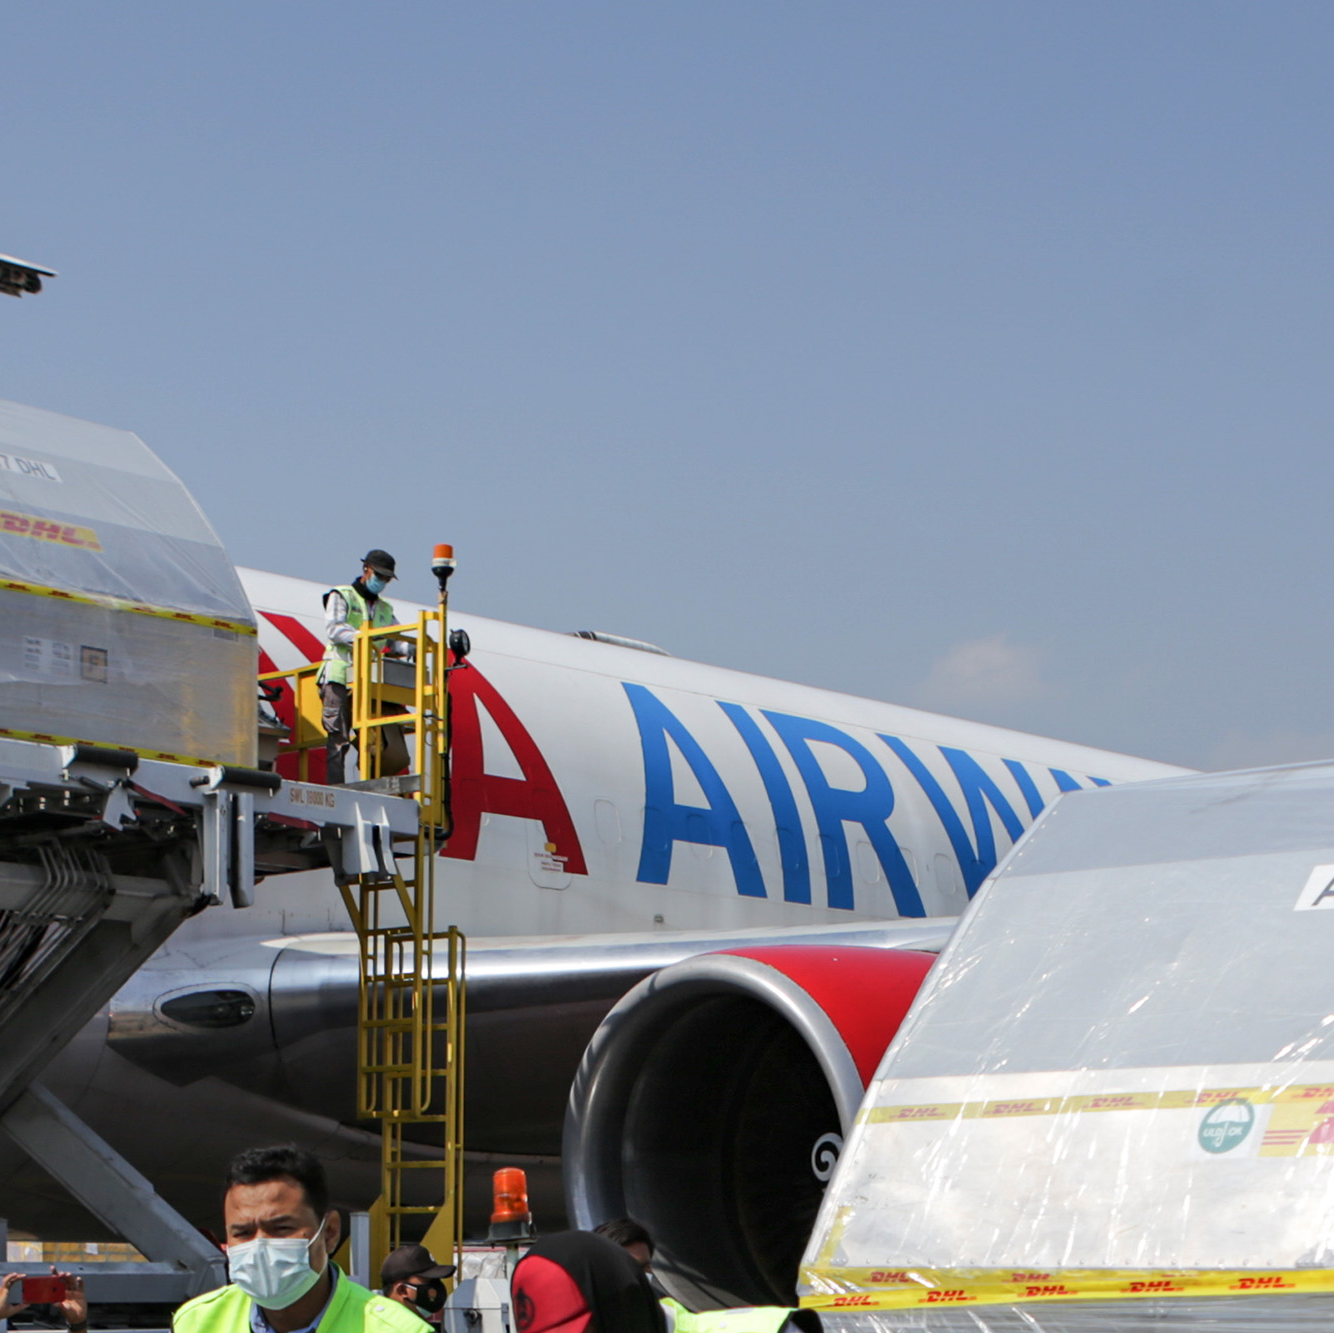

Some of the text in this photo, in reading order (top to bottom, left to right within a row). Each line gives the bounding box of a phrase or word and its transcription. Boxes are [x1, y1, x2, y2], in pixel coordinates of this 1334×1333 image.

[15, 457, 56, 481] DHL
[0, 512, 84, 545] DHL
[619, 681, 1114, 918] AIRW
[992, 1102, 1037, 1115] DHL
[1090, 1096, 1136, 1109] DHL
[897, 1107, 938, 1119] DHL
[870, 1271, 910, 1283] DHL
[1238, 1276, 1285, 1289] DHL
[1026, 1284, 1068, 1297] DHL
[1130, 1281, 1174, 1293] DHL
[833, 1295, 870, 1306] DHL
[927, 1289, 967, 1302] DHL
